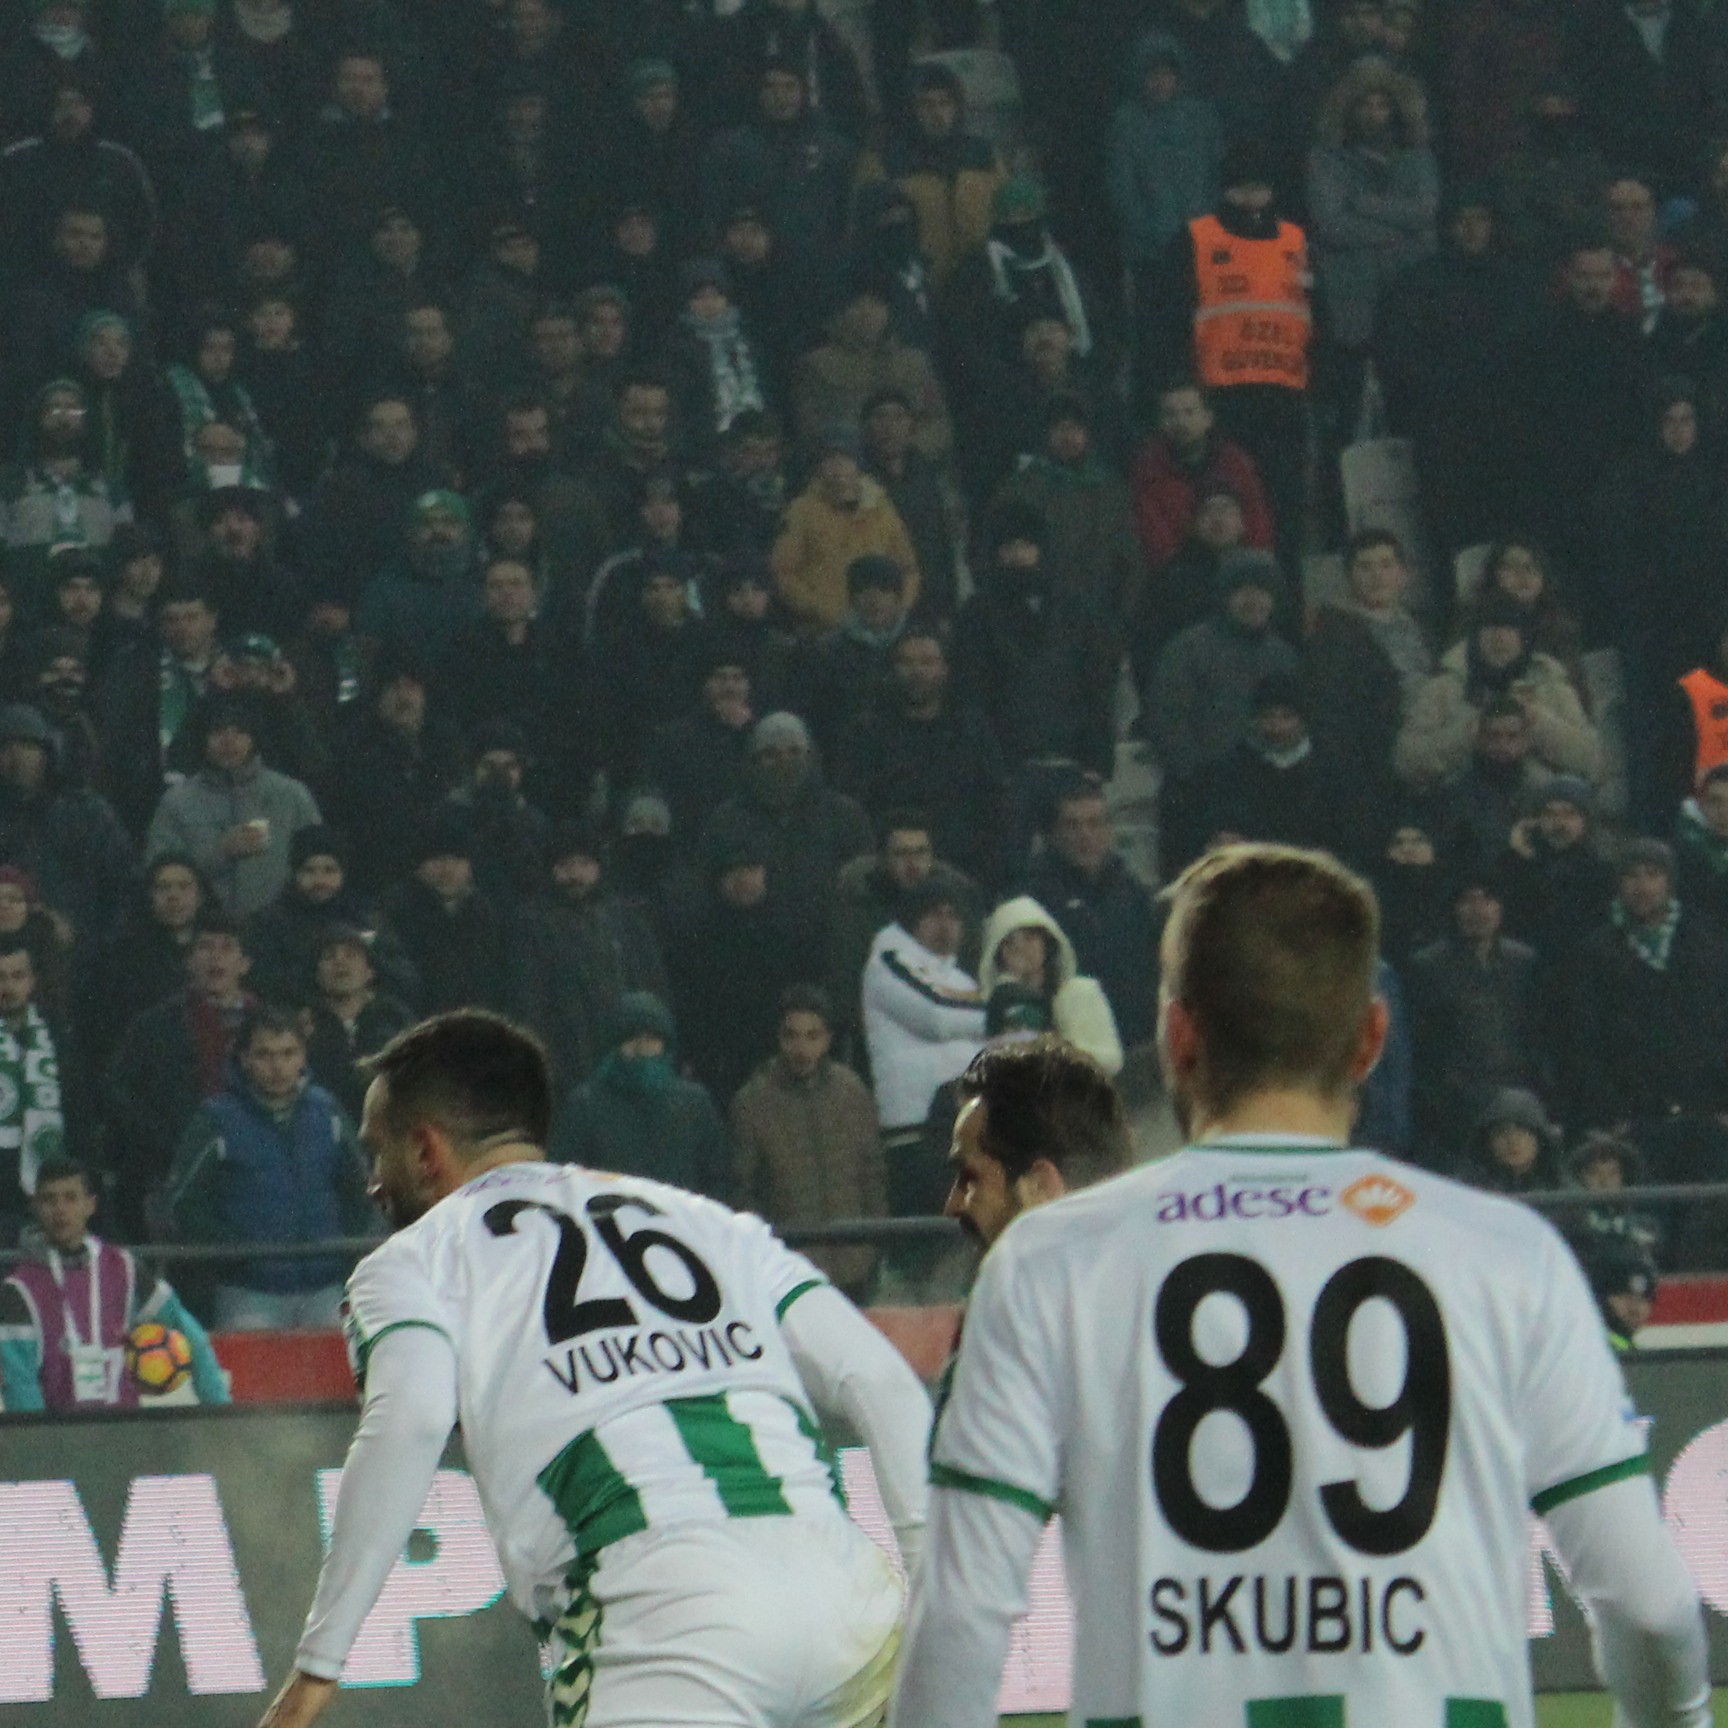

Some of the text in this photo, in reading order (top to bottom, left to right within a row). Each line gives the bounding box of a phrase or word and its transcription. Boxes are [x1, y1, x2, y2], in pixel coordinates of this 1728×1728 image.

[1156, 1178, 1335, 1224] adese
[482, 1194, 723, 1346] 26
[543, 1321, 764, 1397] VUKOVIC
[1150, 1250, 1452, 1557] 89
[1149, 1574, 1428, 1658] SKUBIC
